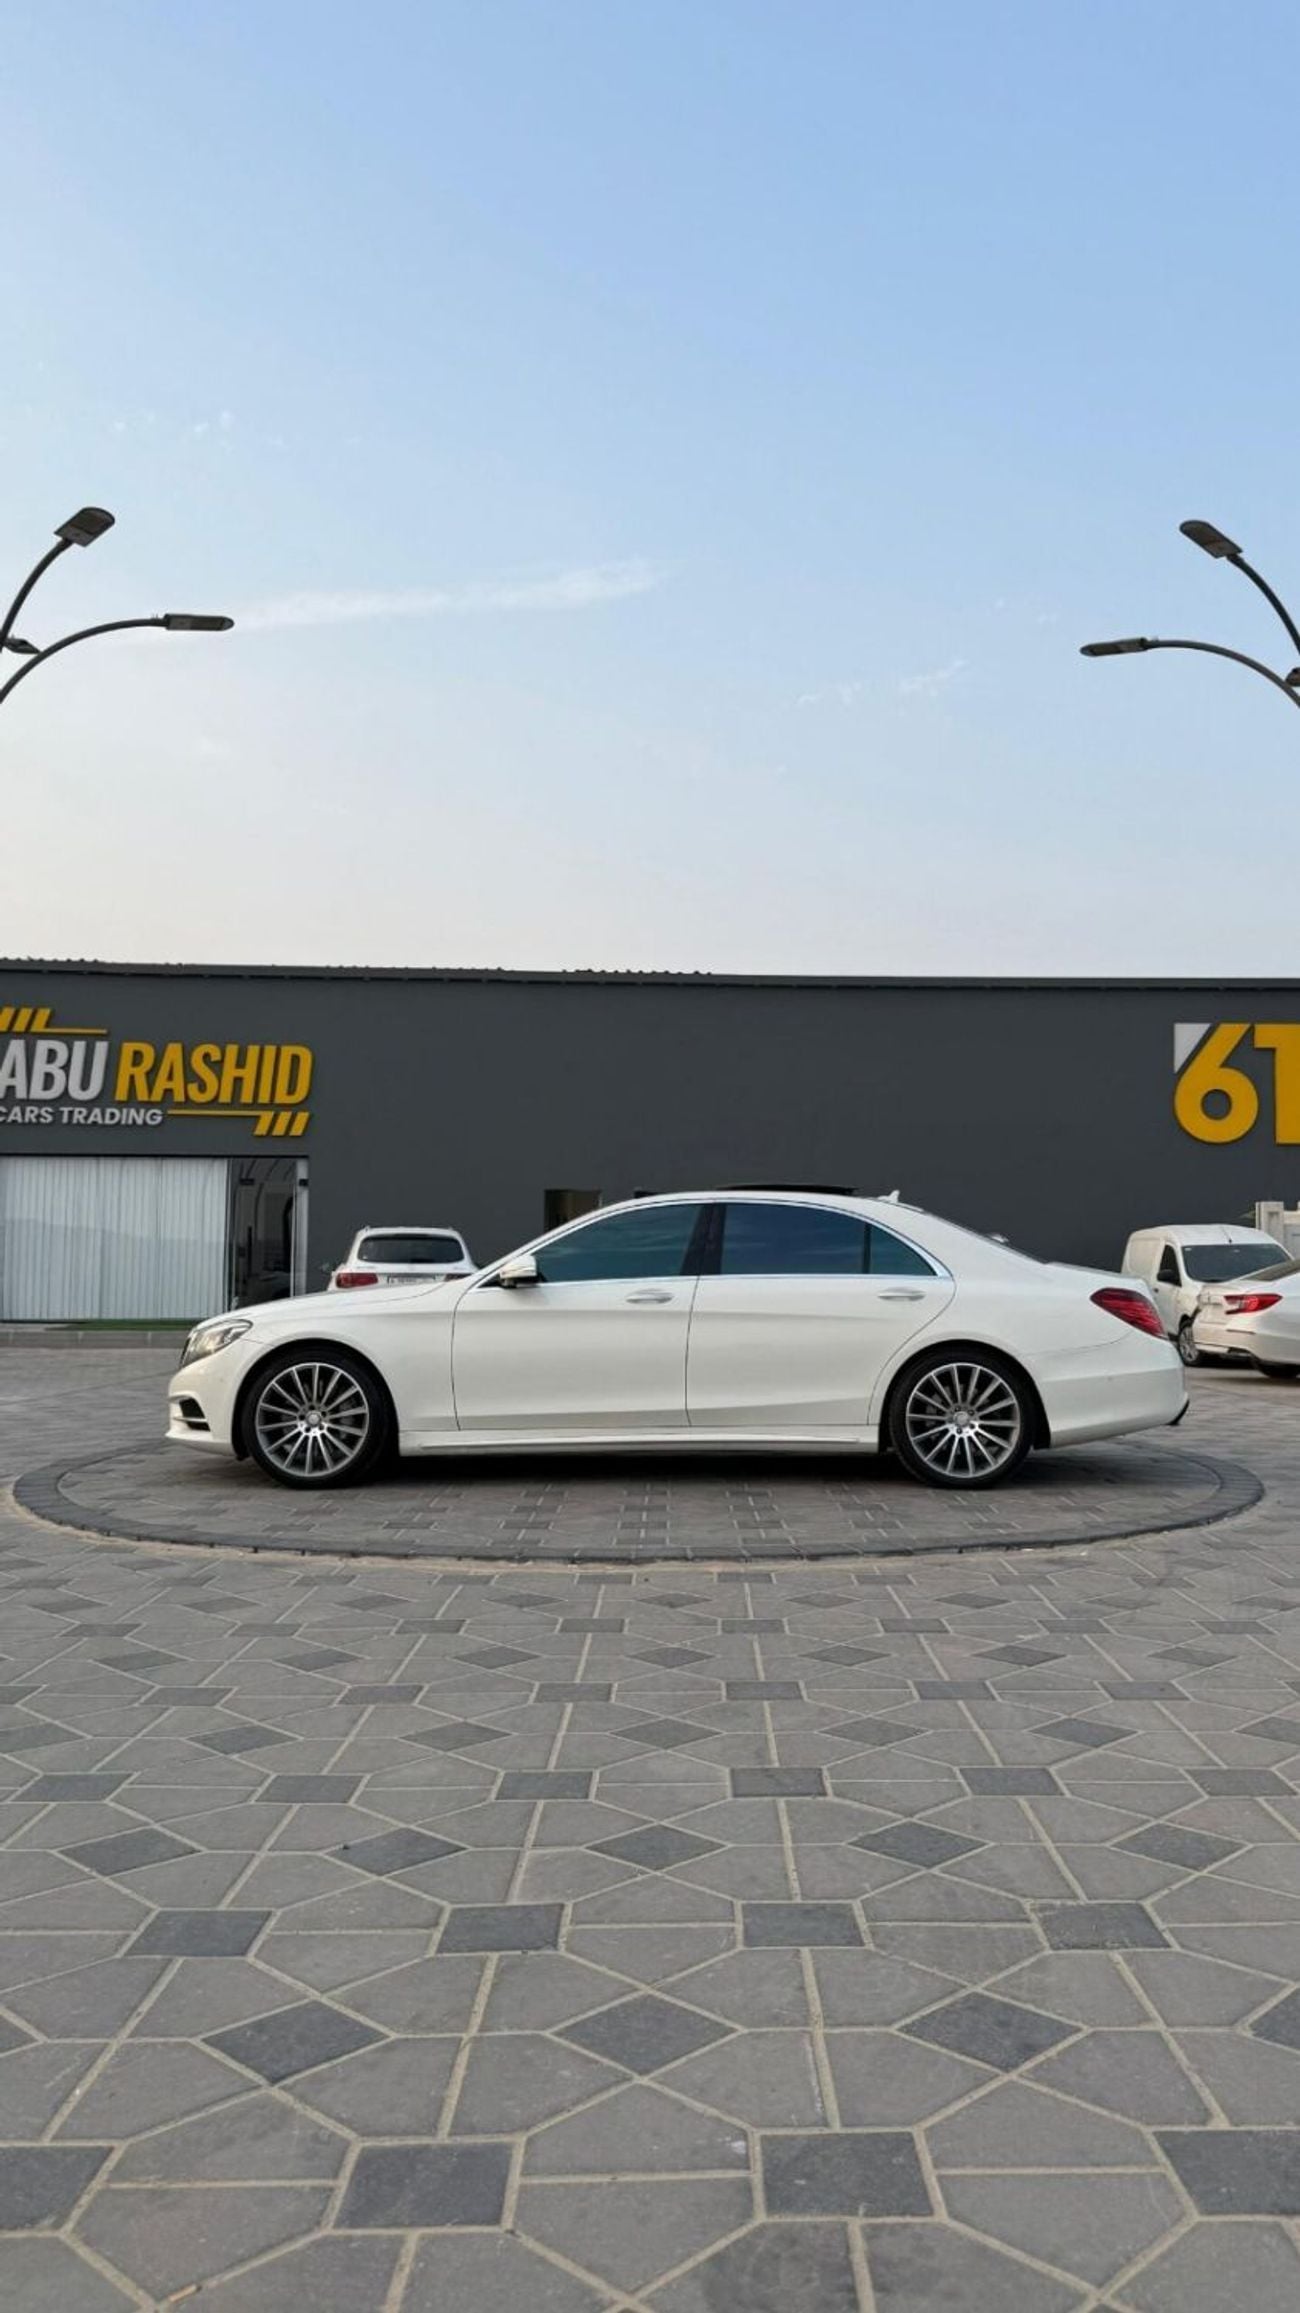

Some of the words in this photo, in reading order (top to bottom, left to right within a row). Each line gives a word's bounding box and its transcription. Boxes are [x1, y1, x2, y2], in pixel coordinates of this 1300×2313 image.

[0, 1039, 109, 1100] ABU
[115, 1042, 313, 1104] RASHID
[60, 1107, 163, 1125] TRADING
